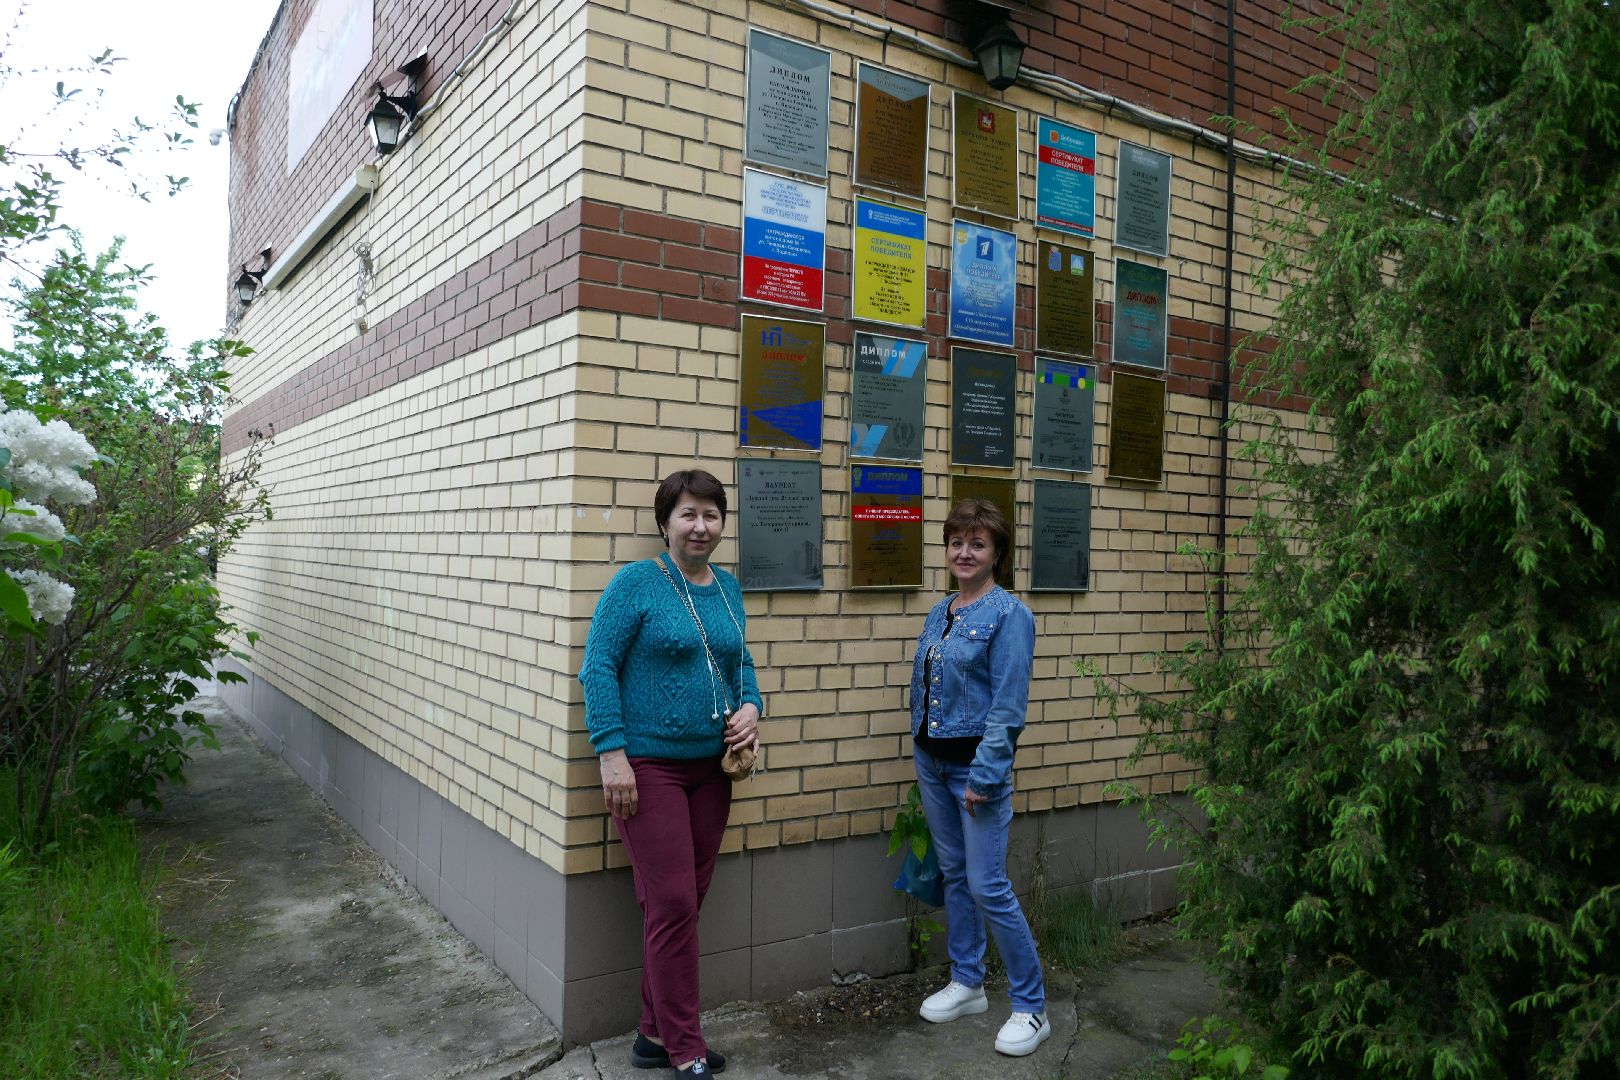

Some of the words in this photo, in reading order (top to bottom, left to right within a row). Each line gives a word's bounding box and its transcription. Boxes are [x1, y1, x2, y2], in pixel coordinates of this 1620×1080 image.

[769, 65, 810, 83] ДИПЛОМ
[1051, 149, 1083, 164] СЕРТИФИКАТ
[1050, 157, 1083, 172] ПОБЕДИТЕЛЯ
[871, 237, 911, 251] СЕРТИФИКАТ
[870, 245, 911, 259] ПОБЕДИТЕЛЯ
[1126, 290, 1156, 305] ДИПЛОМ
[860, 345, 906, 360] ДИПЛОМ
[867, 472, 908, 481] ДИПЛОМ
